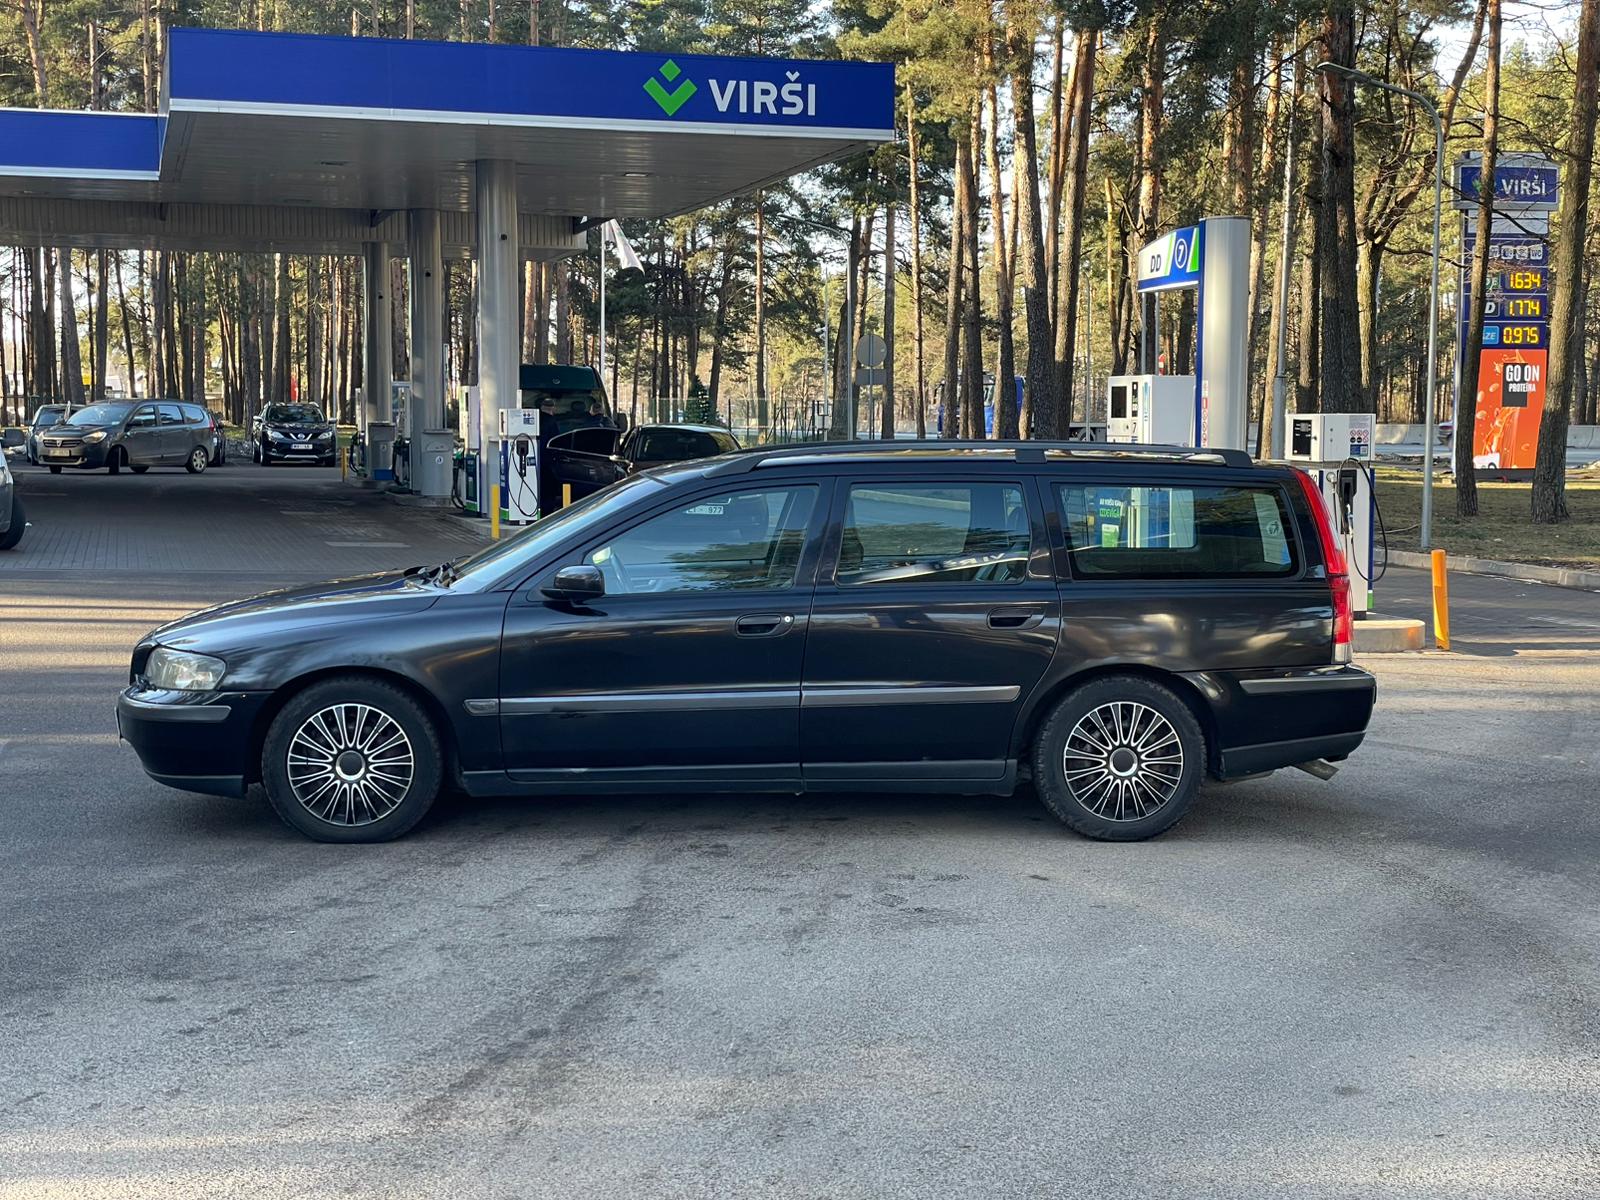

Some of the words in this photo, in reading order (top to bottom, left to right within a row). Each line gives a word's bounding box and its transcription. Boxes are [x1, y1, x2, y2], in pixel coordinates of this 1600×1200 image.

[708, 71, 816, 116] VIRŠI
[1502, 175, 1546, 196] VIRŠI
[1178, 244, 1185, 262] 7
[1150, 254, 1162, 273] DD
[1510, 272, 1541, 290] 1.634
[1510, 300, 1540, 317] 1.774
[1504, 326, 1539, 344] 0.975
[1505, 364, 1522, 383] GO
[1524, 364, 1540, 383] ON
